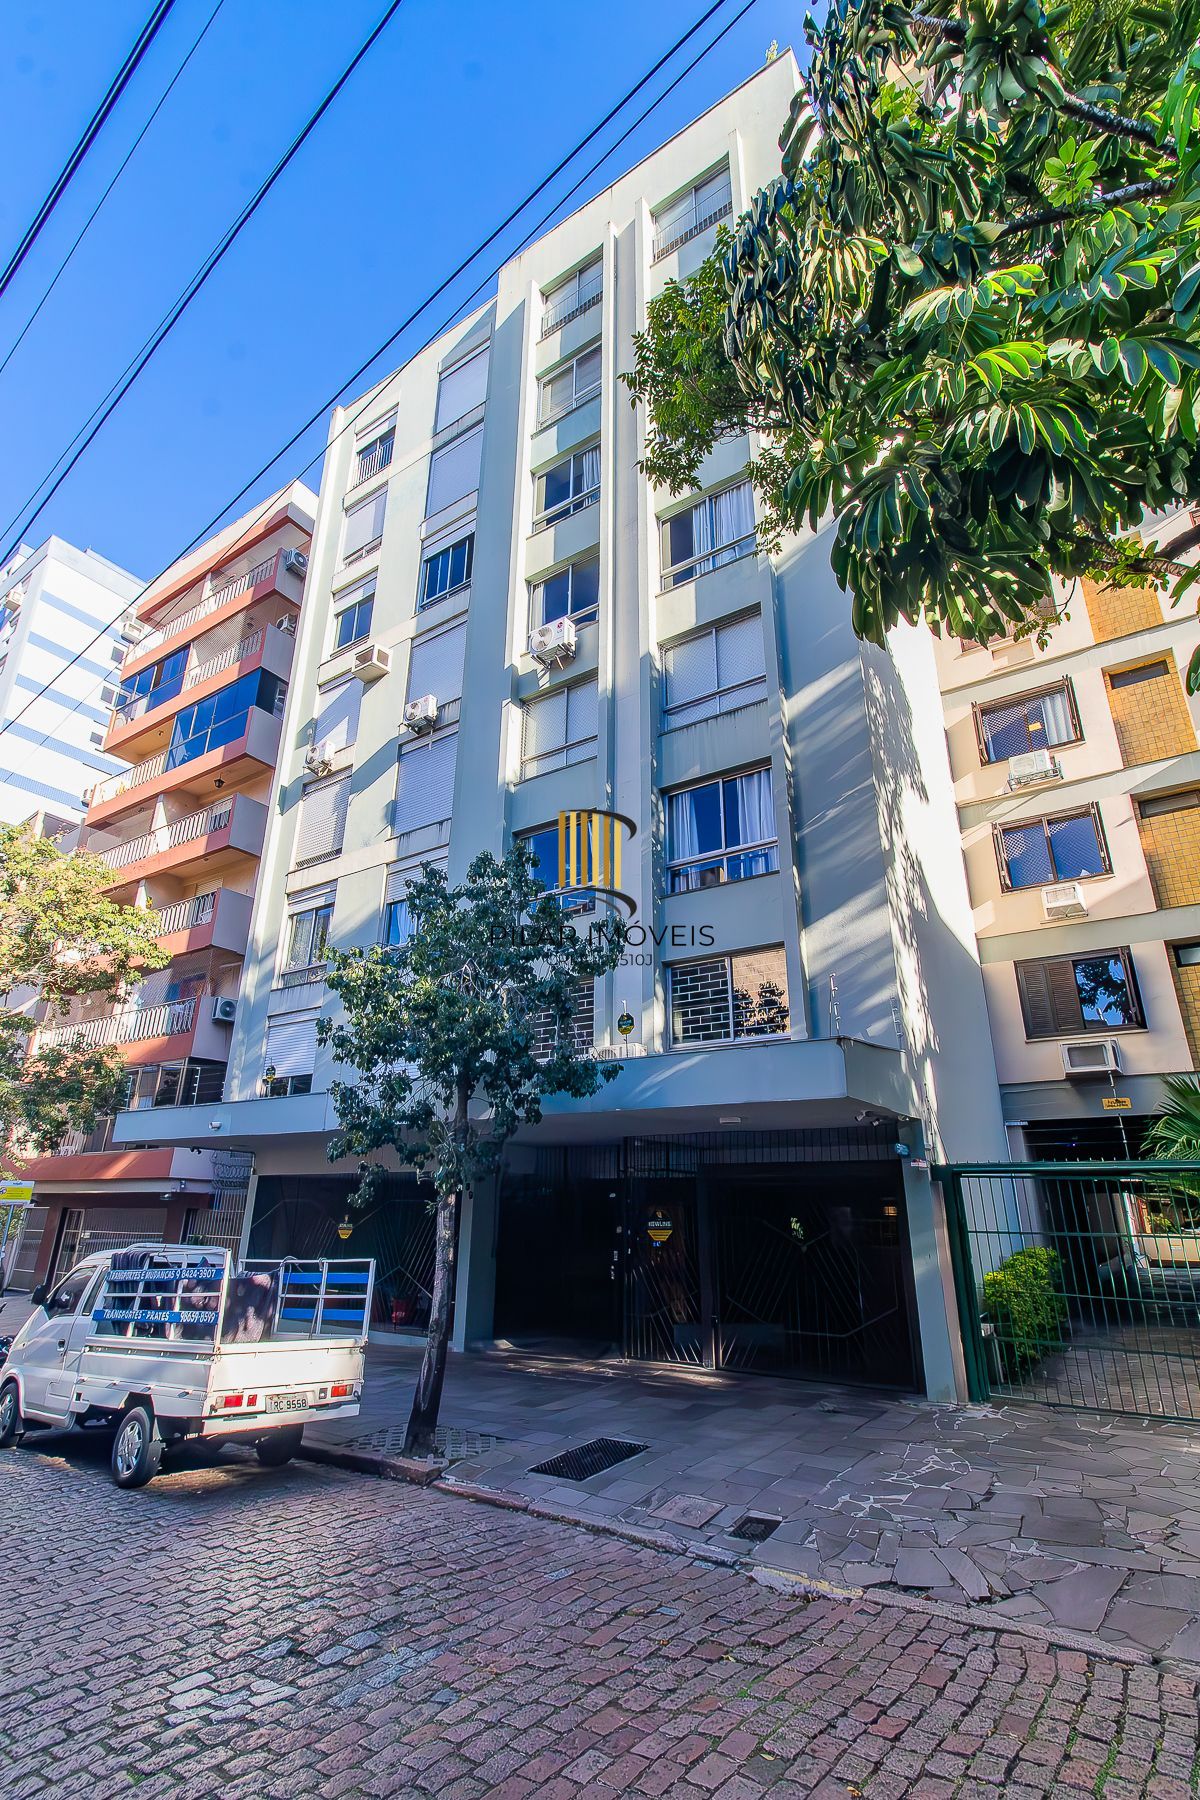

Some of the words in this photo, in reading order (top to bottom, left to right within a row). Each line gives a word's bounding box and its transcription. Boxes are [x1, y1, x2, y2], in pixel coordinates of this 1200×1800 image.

[109, 1270, 141, 1281] TRANSPORTES
[103, 1310, 142, 1320] TRANSPORTES
[146, 1311, 170, 1321] PRATES
[286, 1399, 307, 1410] 9558
